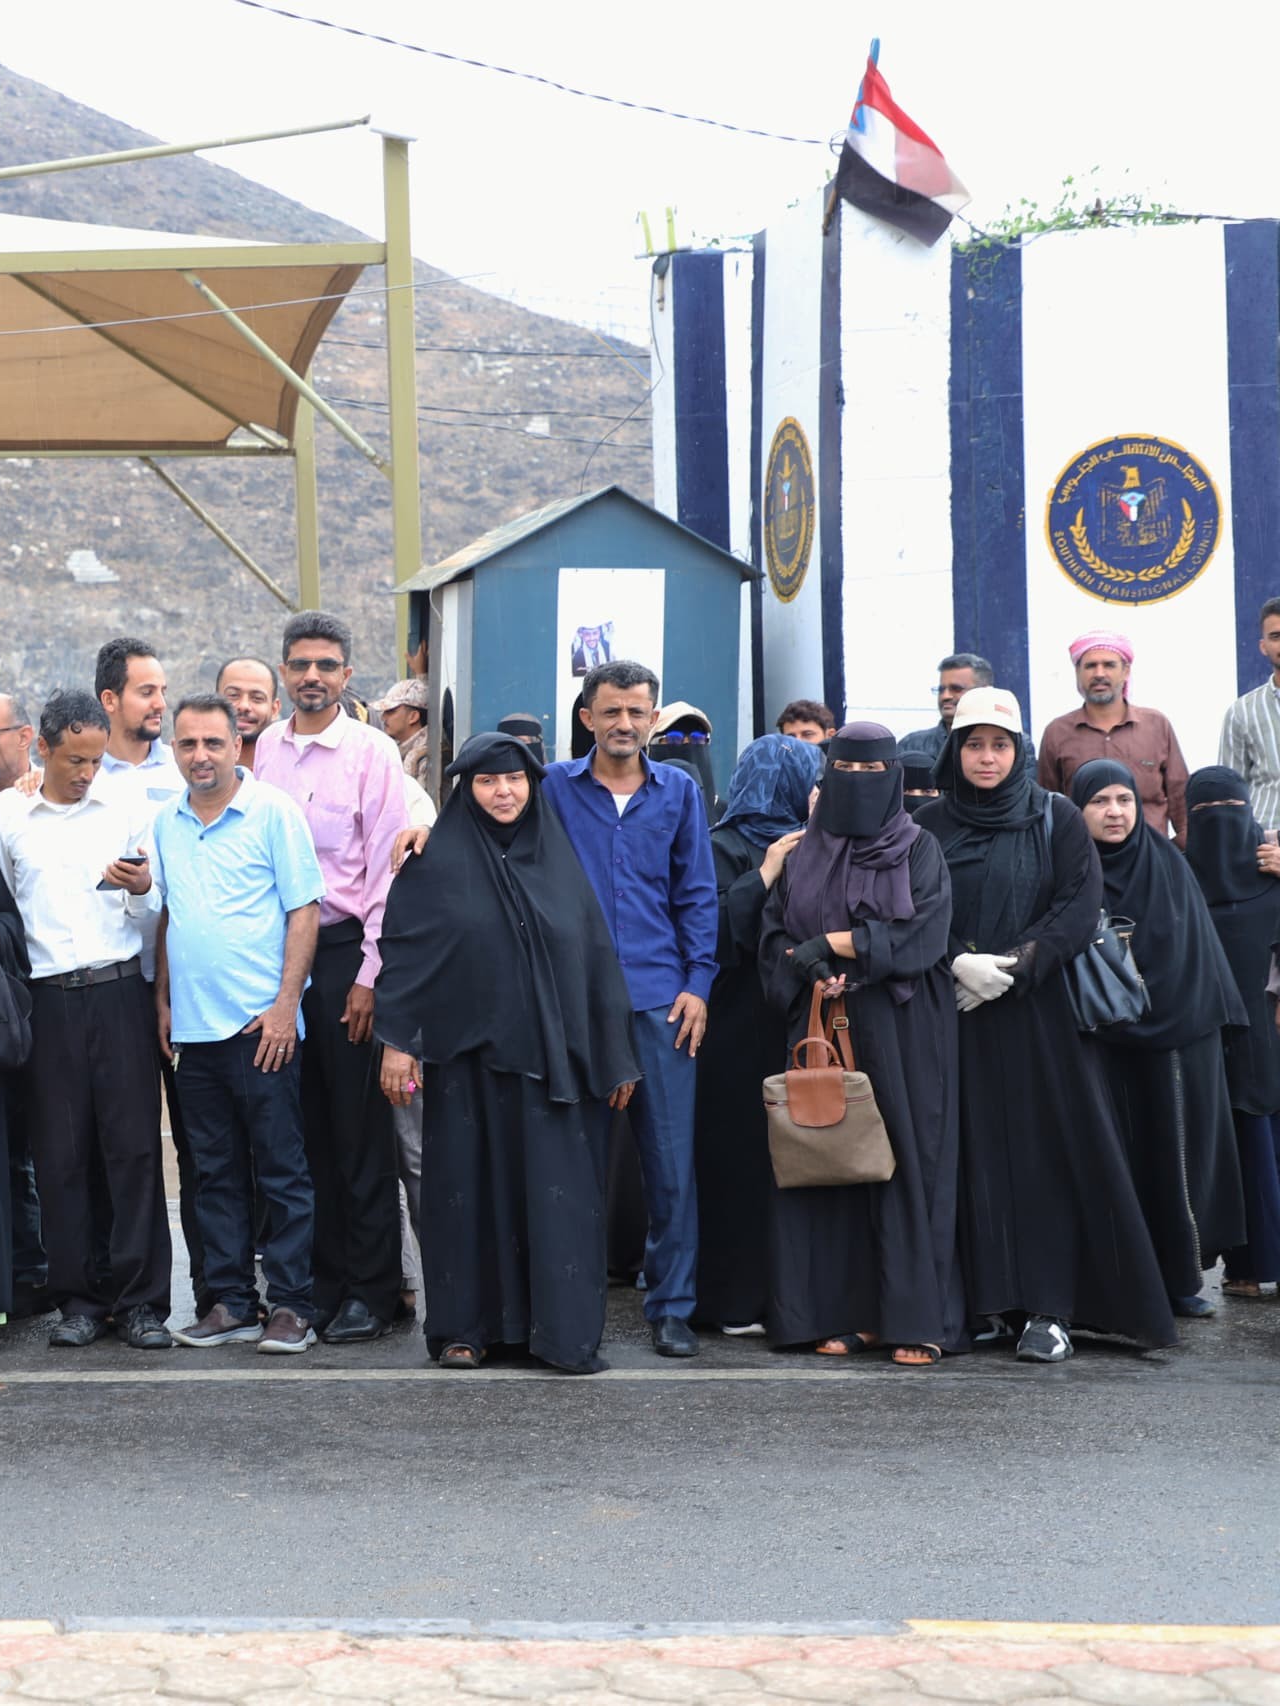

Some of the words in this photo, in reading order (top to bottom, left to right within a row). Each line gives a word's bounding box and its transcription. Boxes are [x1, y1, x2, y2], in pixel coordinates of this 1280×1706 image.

[1054, 531, 1095, 585] SOUTHERN
[1096, 571, 1188, 599] TRANSITIONAL
[1187, 518, 1214, 574] COUNCIL
